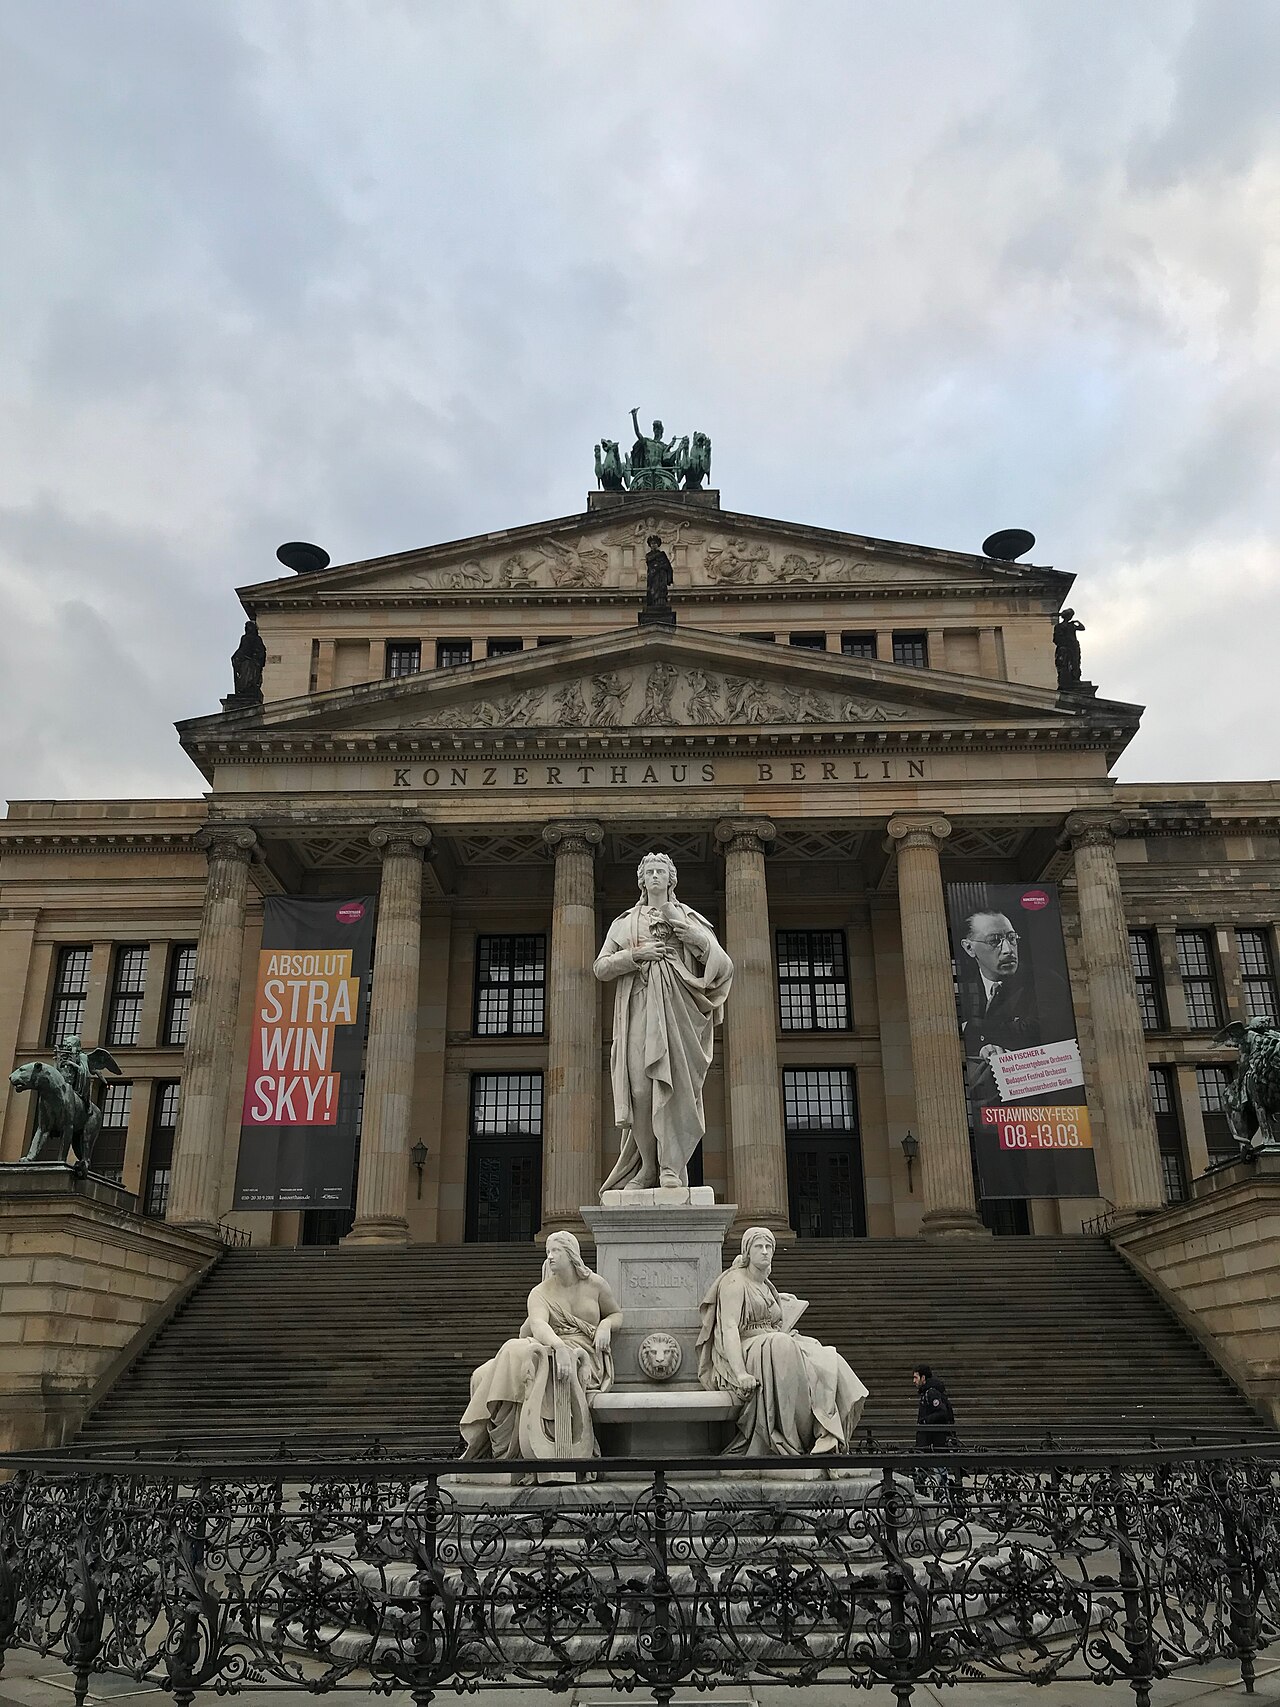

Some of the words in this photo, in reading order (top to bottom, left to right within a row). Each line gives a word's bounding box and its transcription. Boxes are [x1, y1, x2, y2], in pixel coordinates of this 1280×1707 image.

[393, 764, 715, 786] KONZERTHAUS
[757, 760, 925, 781] BERLIN
[267, 954, 347, 976] ABSOLUT
[261, 979, 351, 1023] STRA
[261, 1027, 329, 1071] WIN
[1014, 1049, 1040, 1060] FISCHER
[1001, 1065, 1015, 1074] Royal
[1049, 1054, 1073, 1064] Orchestra
[1005, 1075, 1027, 1085] Budapest
[1027, 1071, 1045, 1080] Festival
[1045, 1067, 1067, 1077] Orchester
[1058, 1078, 1073, 1086] Berlin
[251, 1075, 334, 1122] SKY!
[985, 1107, 1080, 1122] STRAWINSKY-FEST
[1004, 1124, 1083, 1148] 08.-13.03.
